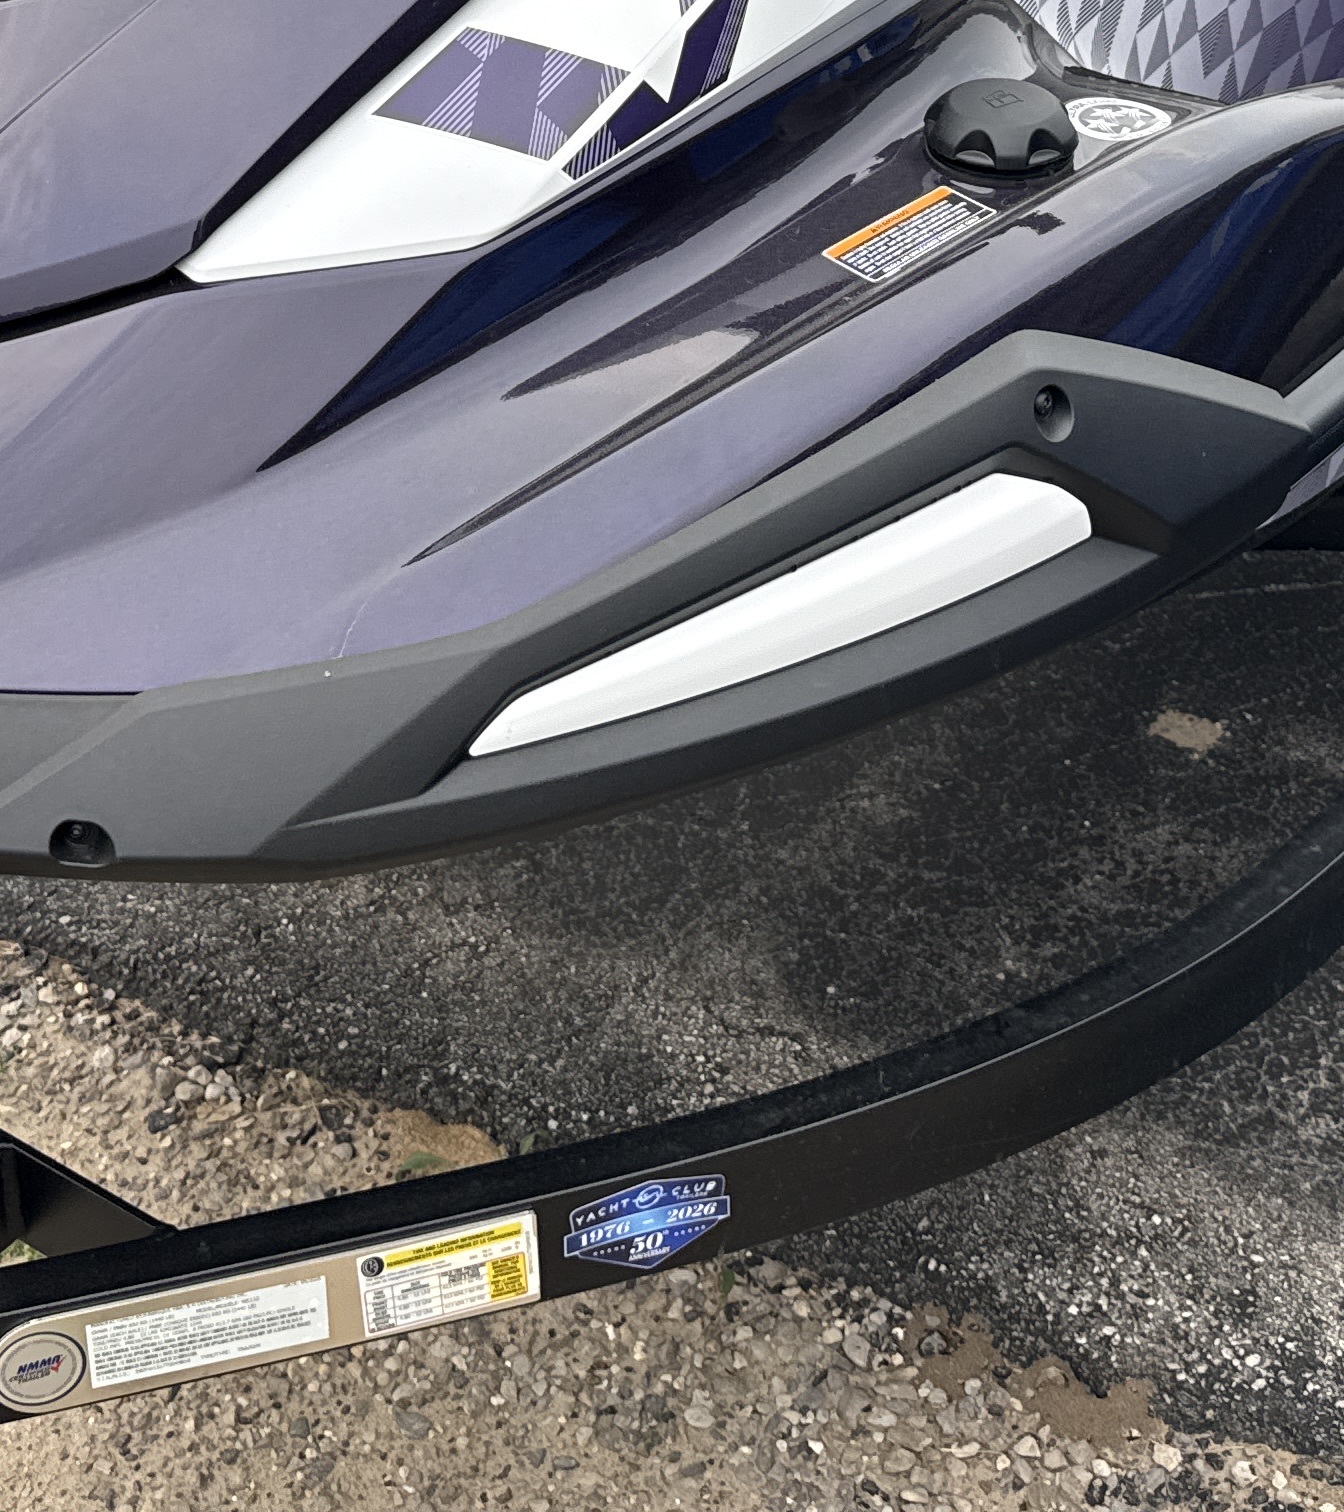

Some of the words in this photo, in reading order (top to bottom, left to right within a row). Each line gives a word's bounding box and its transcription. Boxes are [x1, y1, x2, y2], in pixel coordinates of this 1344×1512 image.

[575, 1198, 631, 1226] YACHT
[671, 1180, 717, 1196] CLUB
[579, 1220, 631, 1248] 1976
[666, 1202, 718, 1223] 2026
